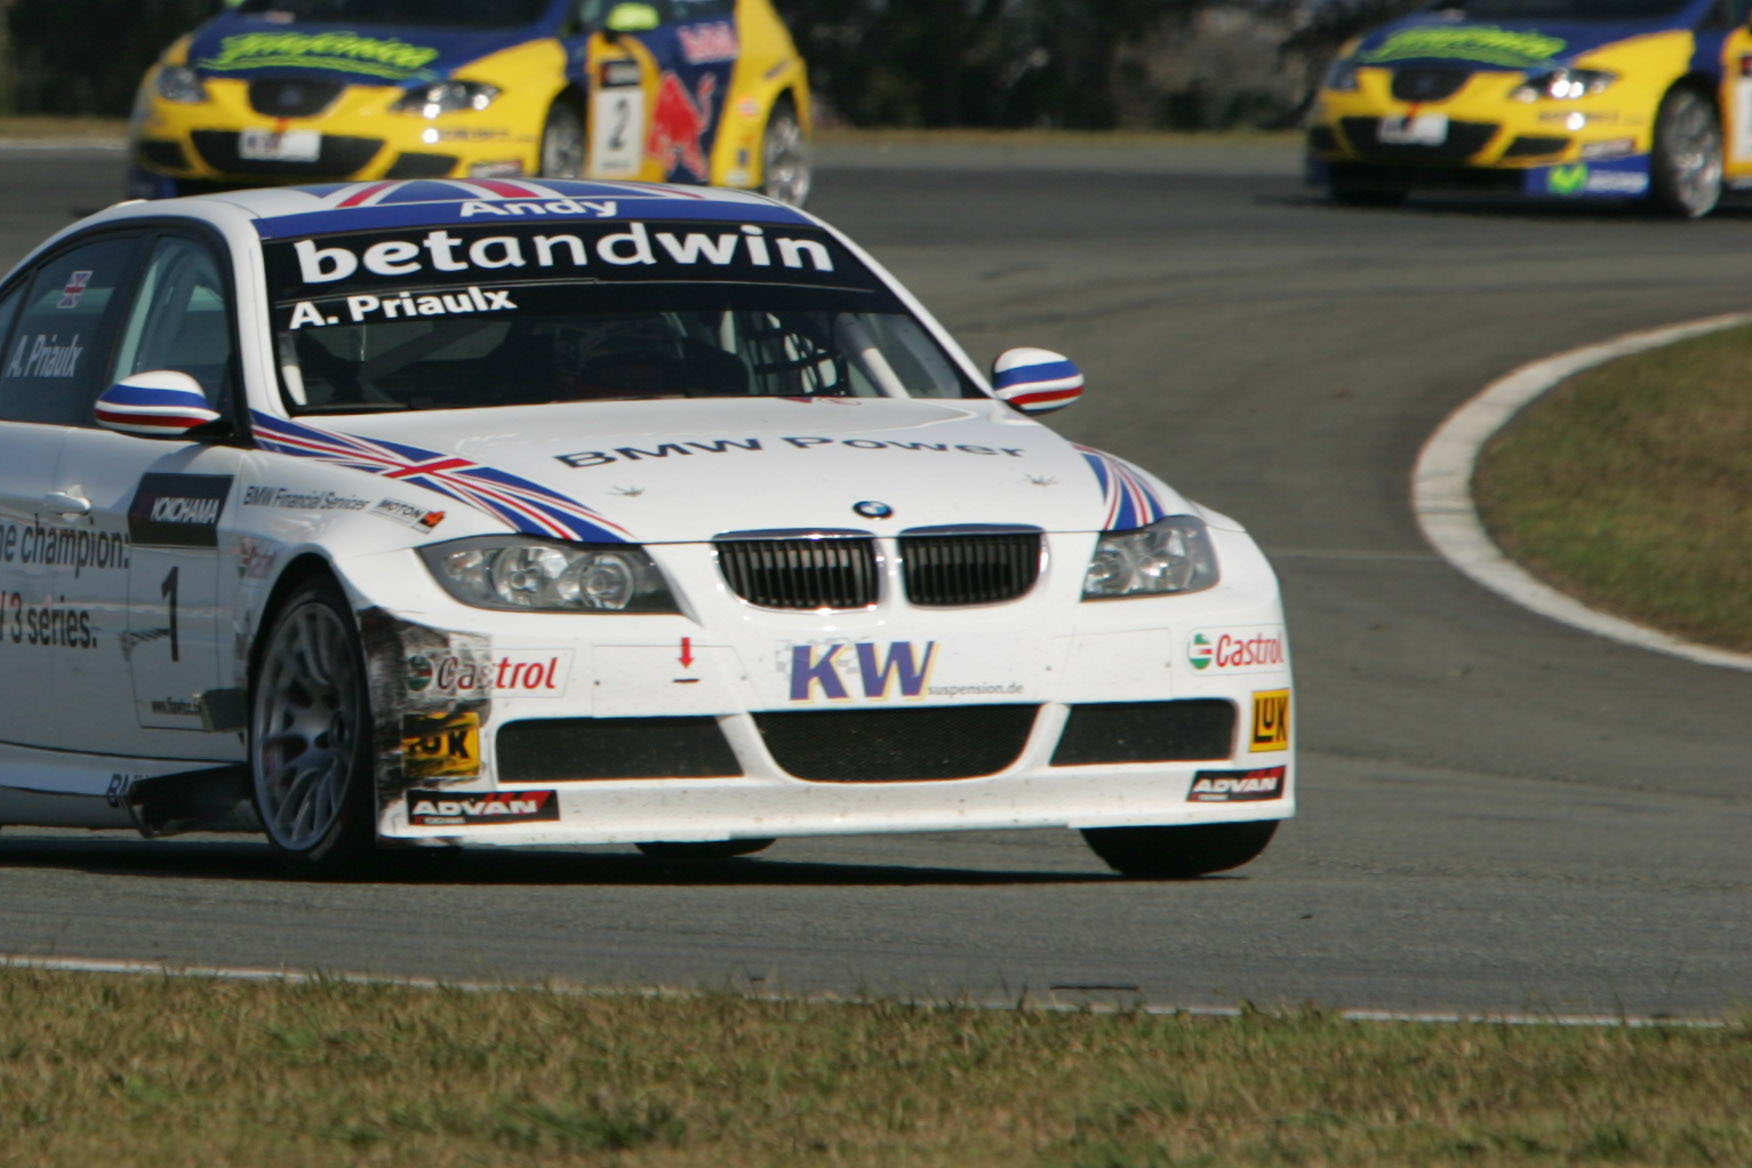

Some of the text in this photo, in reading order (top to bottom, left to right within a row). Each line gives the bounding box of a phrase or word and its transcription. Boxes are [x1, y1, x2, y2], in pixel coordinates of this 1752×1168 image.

[460, 199, 618, 217] Andy
[294, 223, 834, 284] betandwin
[289, 286, 518, 329] A. Priaulx
[24, 333, 84, 378] Priaulx
[554, 436, 1027, 468] BMW Power
[151, 497, 219, 524] YOKOHAMA
[244, 486, 273, 506] BMW
[273, 487, 321, 509] Financial
[377, 499, 424, 519] MOTON
[10, 592, 23, 644] 3
[27, 595, 98, 649] series.
[161, 566, 181, 662] 1
[1217, 634, 1286, 667] Castrol
[437, 656, 558, 690] Castrol
[789, 640, 940, 702] KW
[928, 682, 1024, 698] suspension.de
[1194, 777, 1278, 793] ADVAN
[412, 799, 538, 815] ADVAN
